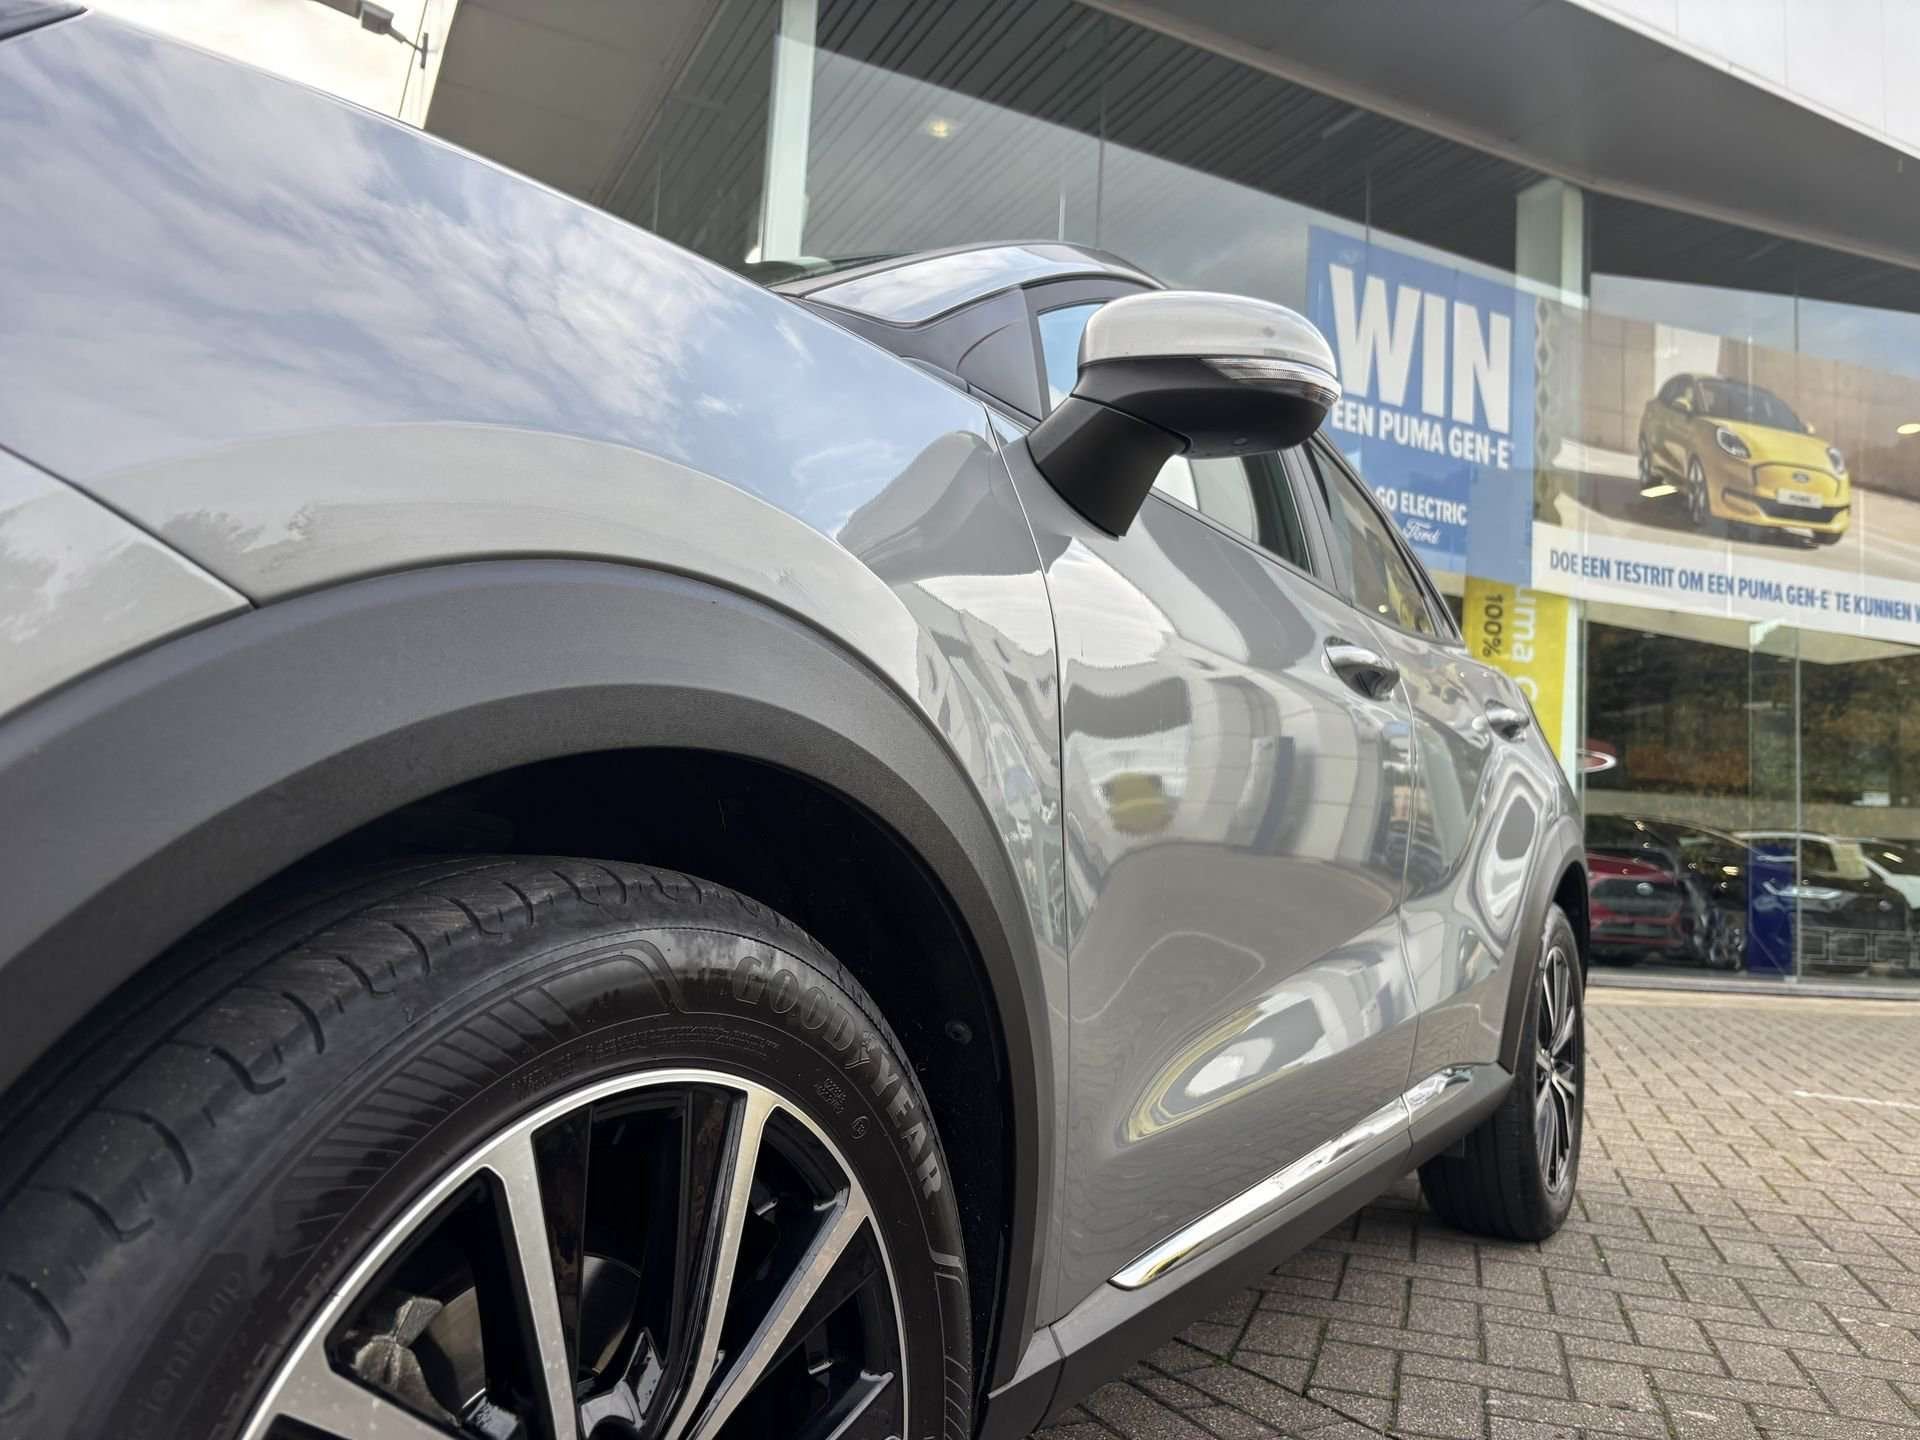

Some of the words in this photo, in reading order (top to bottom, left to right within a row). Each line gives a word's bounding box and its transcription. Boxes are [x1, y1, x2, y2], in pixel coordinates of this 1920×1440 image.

[1329, 263, 1511, 434] WIN
[1331, 400, 1373, 437] EEN
[1379, 410, 1445, 455] PUMA
[1375, 485, 1398, 512] GO
[1400, 491, 1467, 527] ELECTRIC
[1402, 518, 1441, 545] Ford
[1550, 549, 1579, 574] DOE
[1582, 556, 1611, 579] EEN
[1614, 561, 1674, 589] TESTRIT
[1678, 569, 1704, 592] OM
[1707, 573, 1734, 597] EEN
[1738, 578, 1784, 603] PUMA
[1835, 592, 1851, 614] TE
[1853, 595, 1912, 622] KUNNEN
[1482, 593, 1504, 658] 100%
